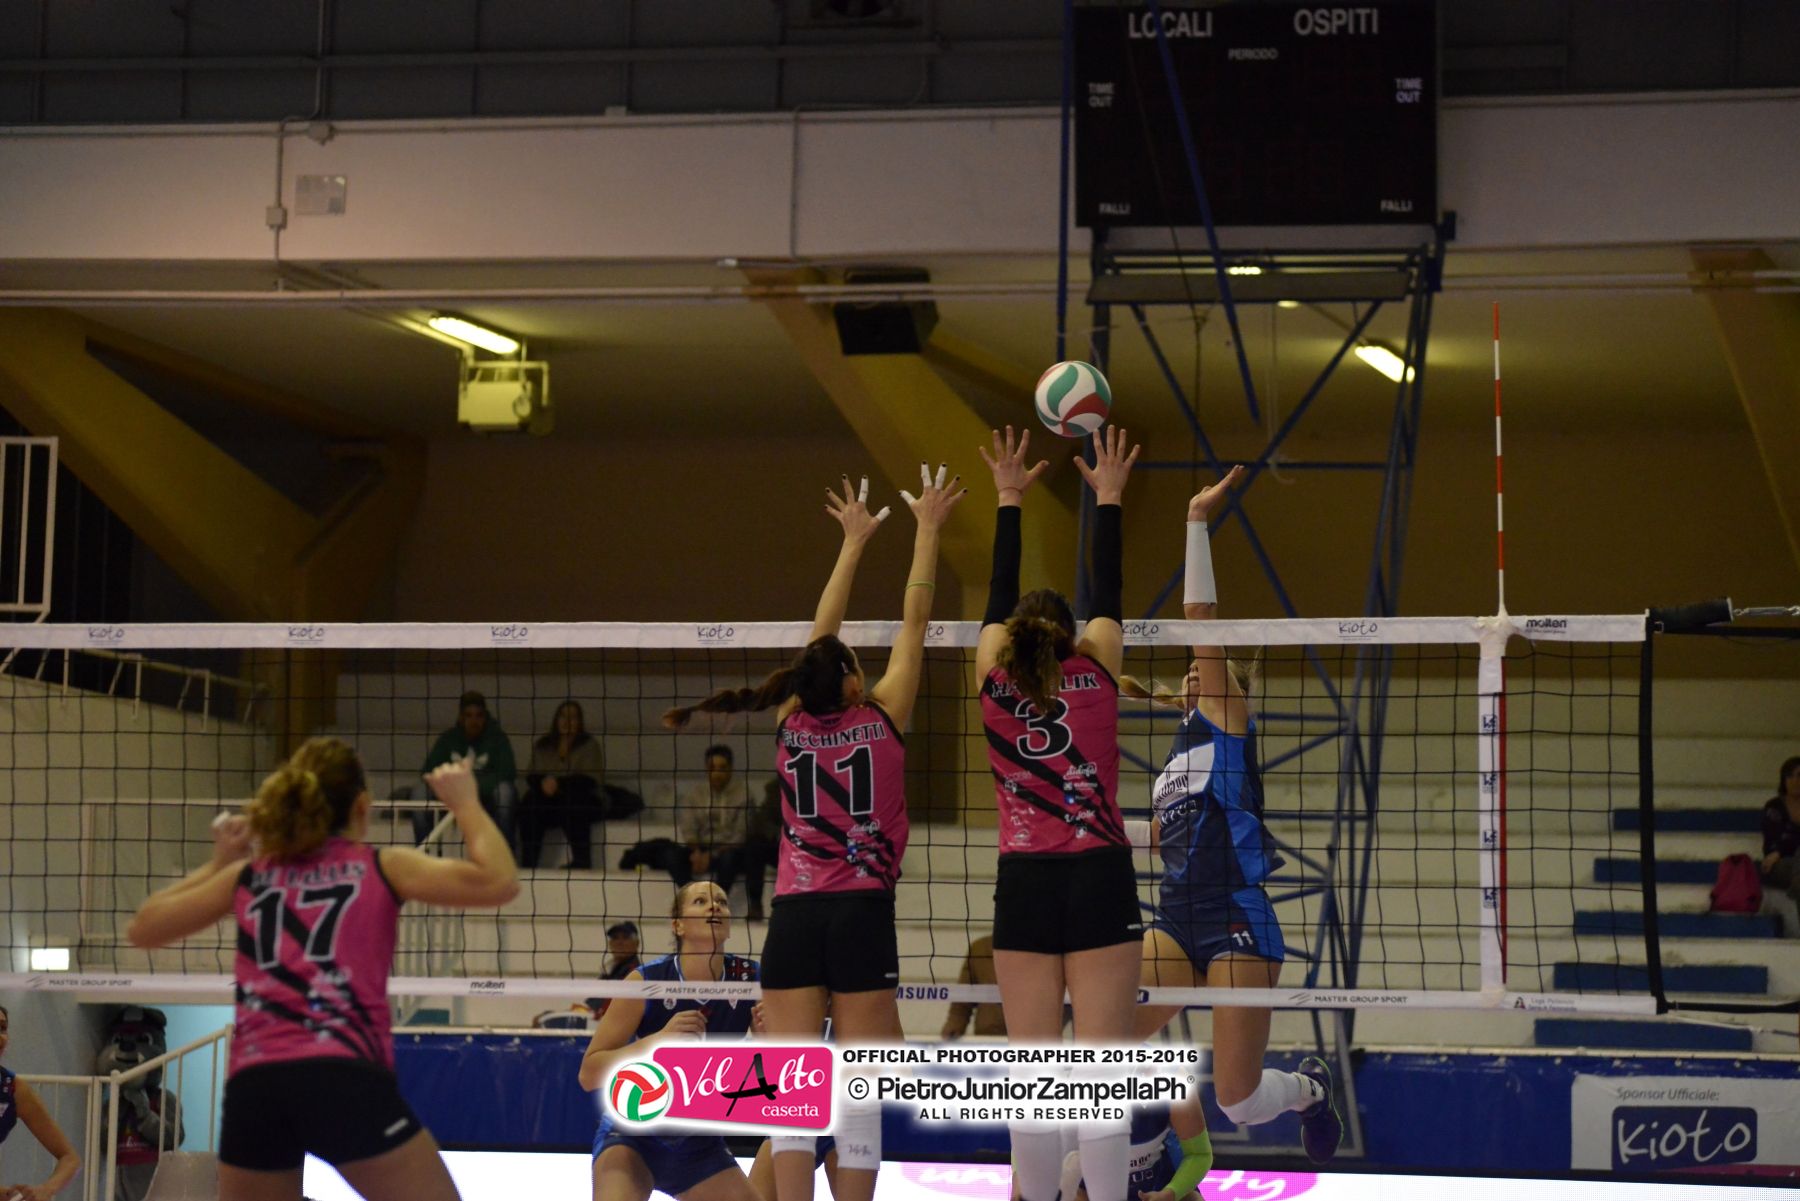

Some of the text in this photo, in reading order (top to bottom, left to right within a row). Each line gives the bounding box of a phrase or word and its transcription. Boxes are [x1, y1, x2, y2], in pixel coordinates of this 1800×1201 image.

[1128, 12, 1213, 39] LOCALI
[1294, 8, 1379, 35] OSPITI
[1228, 48, 1278, 60] PERIODO
[1088, 82, 1115, 95] TIME
[1395, 78, 1422, 90] TIME
[1088, 95, 1113, 108] OUT
[1396, 90, 1421, 103] OUT
[1099, 203, 1130, 215] FALLI
[1380, 199, 1412, 212] FALLI
[1526, 618, 1567, 629] molten
[1014, 695, 1073, 760] 3
[784, 744, 874, 818] 11
[246, 880, 360, 970] 17
[1232, 930, 1253, 947] 11
[896, 986, 949, 1000] MSUNG
[1314, 995, 1408, 1003] MASTER GROUP SPORT
[1616, 1087, 1720, 1101] Sponsor Ufficiale:
